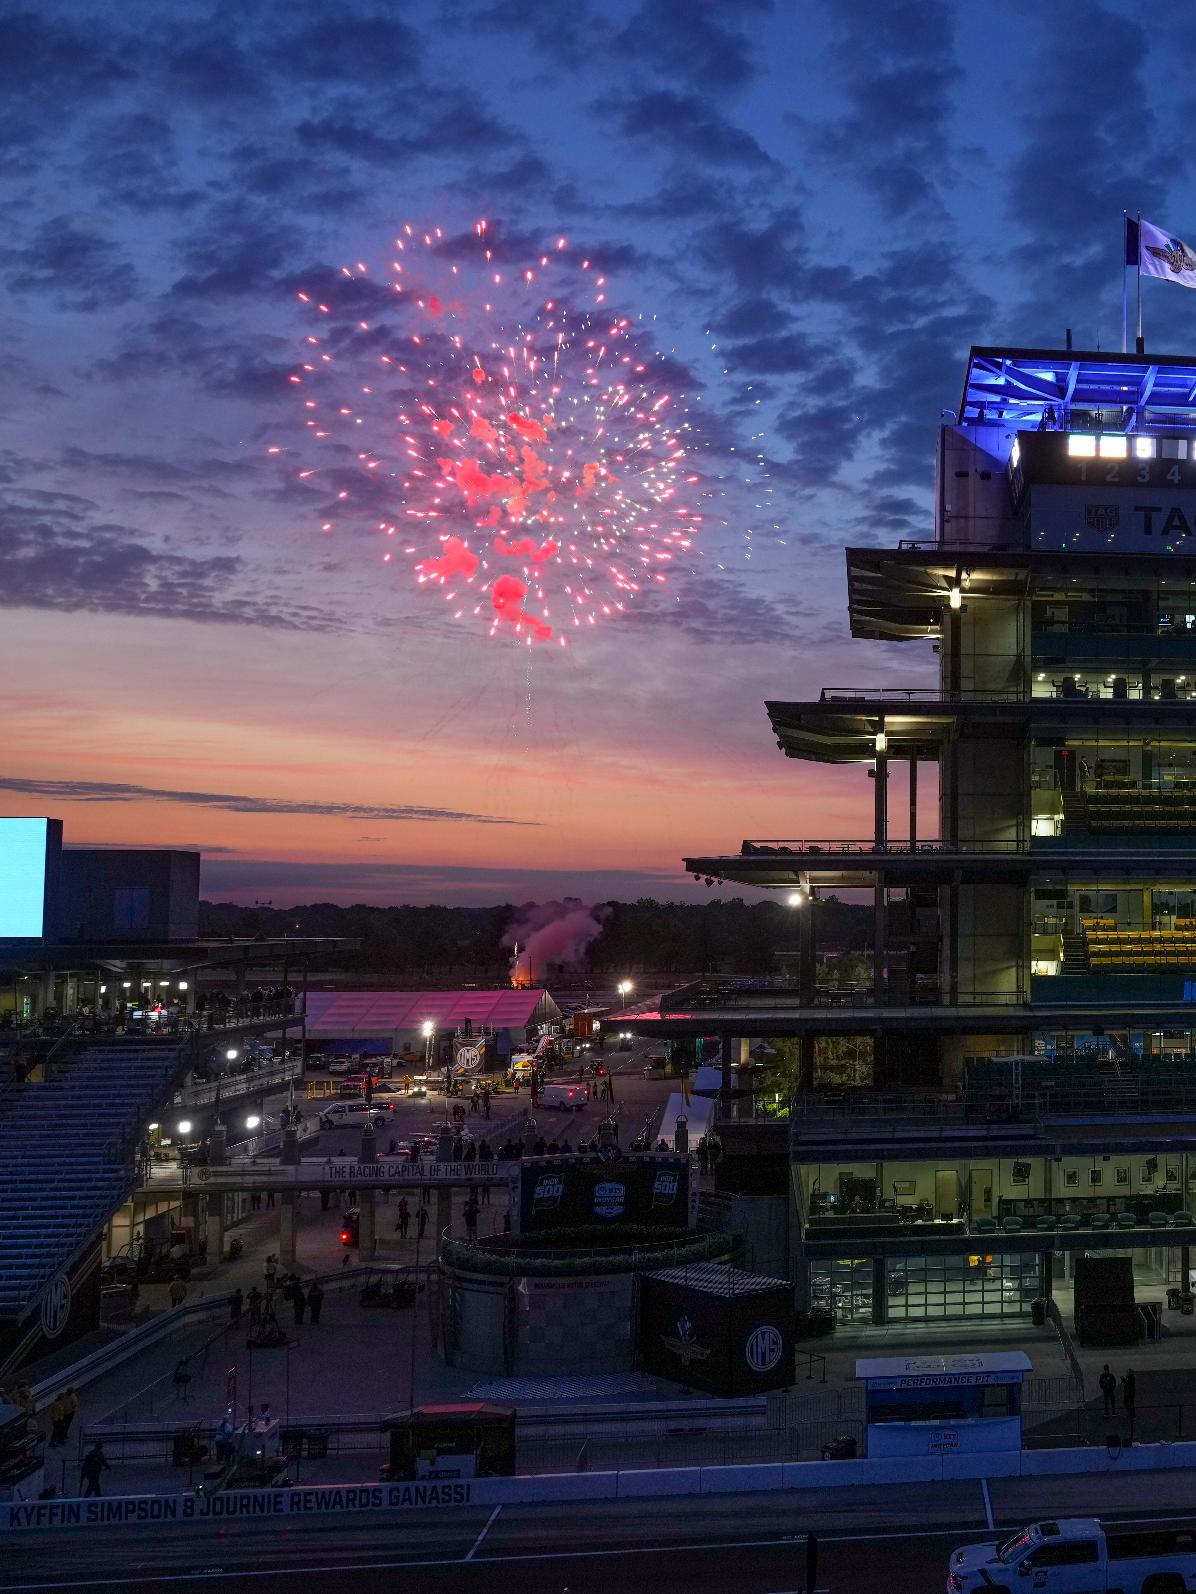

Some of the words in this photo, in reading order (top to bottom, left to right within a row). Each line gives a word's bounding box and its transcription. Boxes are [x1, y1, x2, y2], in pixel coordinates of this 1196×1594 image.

[1079, 464, 1087, 481] 1
[1106, 463, 1119, 482] 2
[1137, 465, 1150, 482] 3
[1167, 466, 1181, 483] 4
[459, 1048, 479, 1067] IMS
[329, 1166, 347, 1178] THE
[350, 1165, 385, 1178] RACING
[388, 1165, 424, 1177] CAPITAL
[430, 1165, 442, 1177] OF
[444, 1164, 461, 1176] THE
[464, 1164, 498, 1176] WORLD
[749, 1332, 779, 1366] IMS
[900, 1376, 972, 1387] PERFORMANCE
[975, 1375, 991, 1384] PIT
[9, 1503, 81, 1527] KYFFIN
[87, 1499, 177, 1523] SIMPSON
[183, 1499, 195, 1517] 8
[200, 1494, 283, 1518] JOURNIE
[290, 1488, 383, 1513] REWARDS
[389, 1484, 471, 1508] GANASSI
